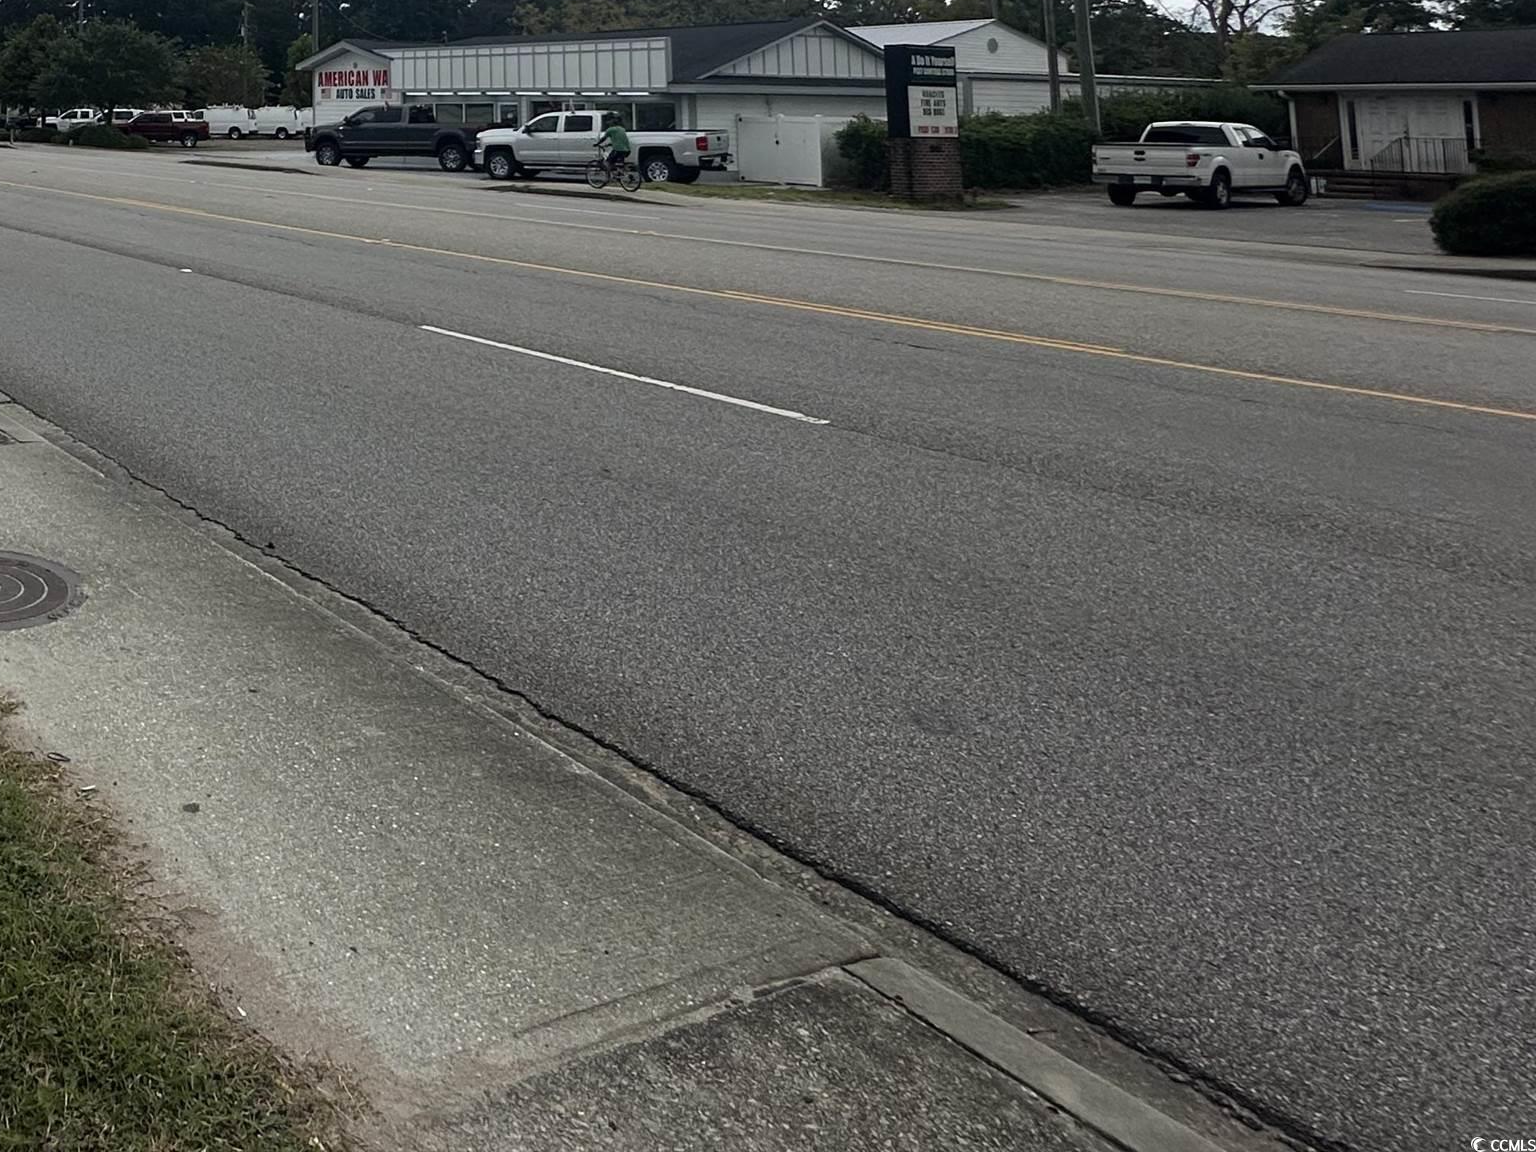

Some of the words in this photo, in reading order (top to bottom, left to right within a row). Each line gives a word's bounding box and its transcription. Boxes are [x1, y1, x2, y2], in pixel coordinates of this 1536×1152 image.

[318, 70, 369, 87] AMERICAN
[372, 70, 389, 86] WA
[336, 88, 353, 99] AUTO
[355, 88, 376, 99] SALES
